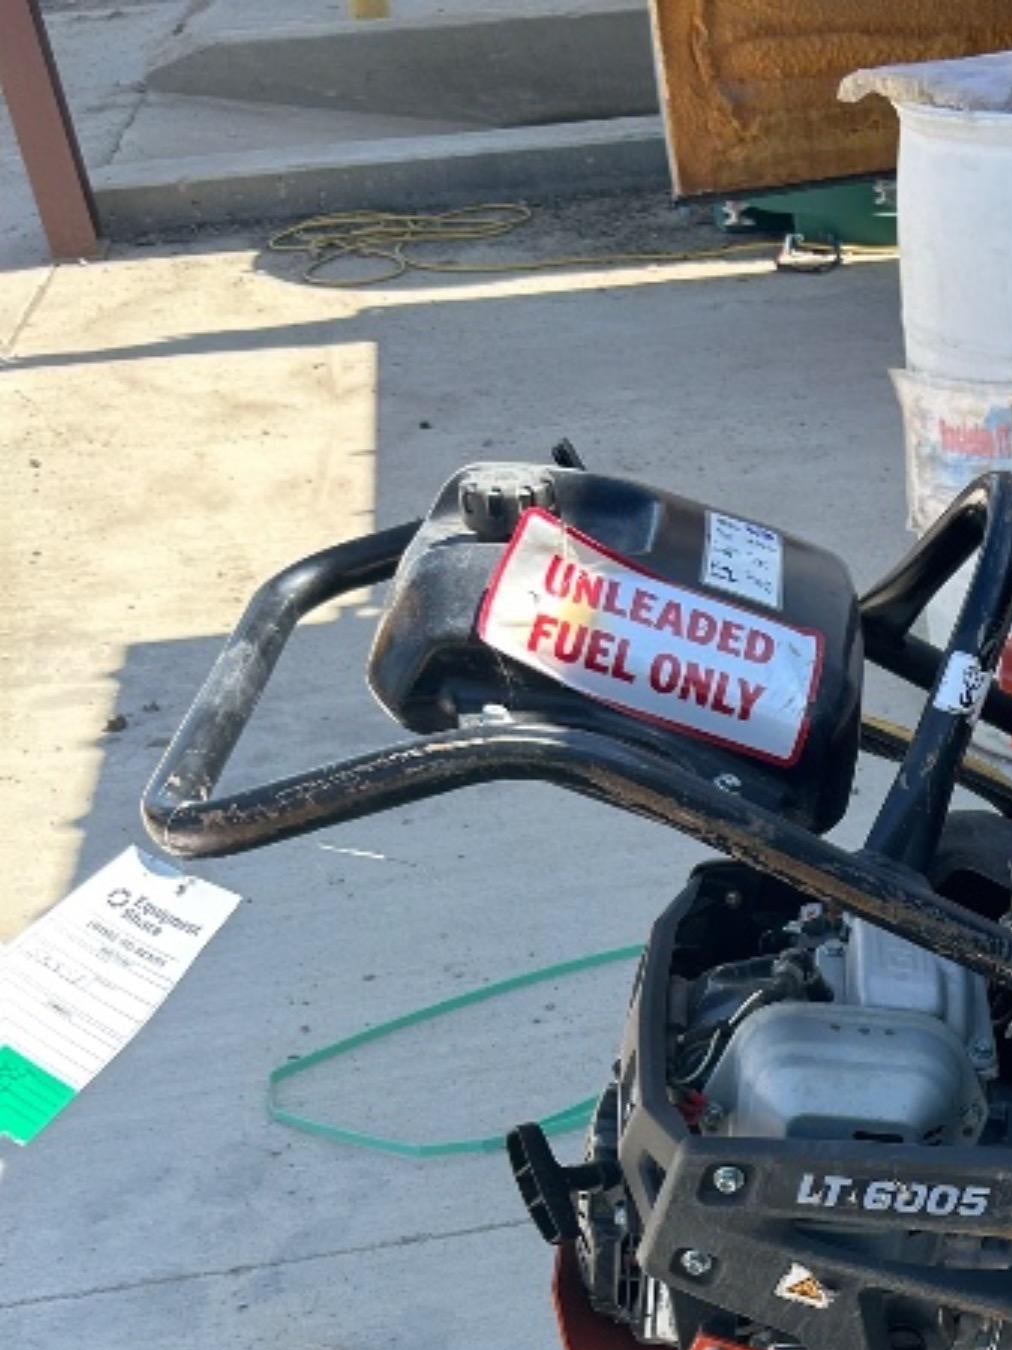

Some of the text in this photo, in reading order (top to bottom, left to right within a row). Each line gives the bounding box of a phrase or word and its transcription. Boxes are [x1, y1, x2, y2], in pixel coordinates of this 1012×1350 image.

[544, 555, 776, 665] UNLEADED
[526, 614, 767, 722] FUEL ONLY
[863, 1178, 991, 1217] 6005
